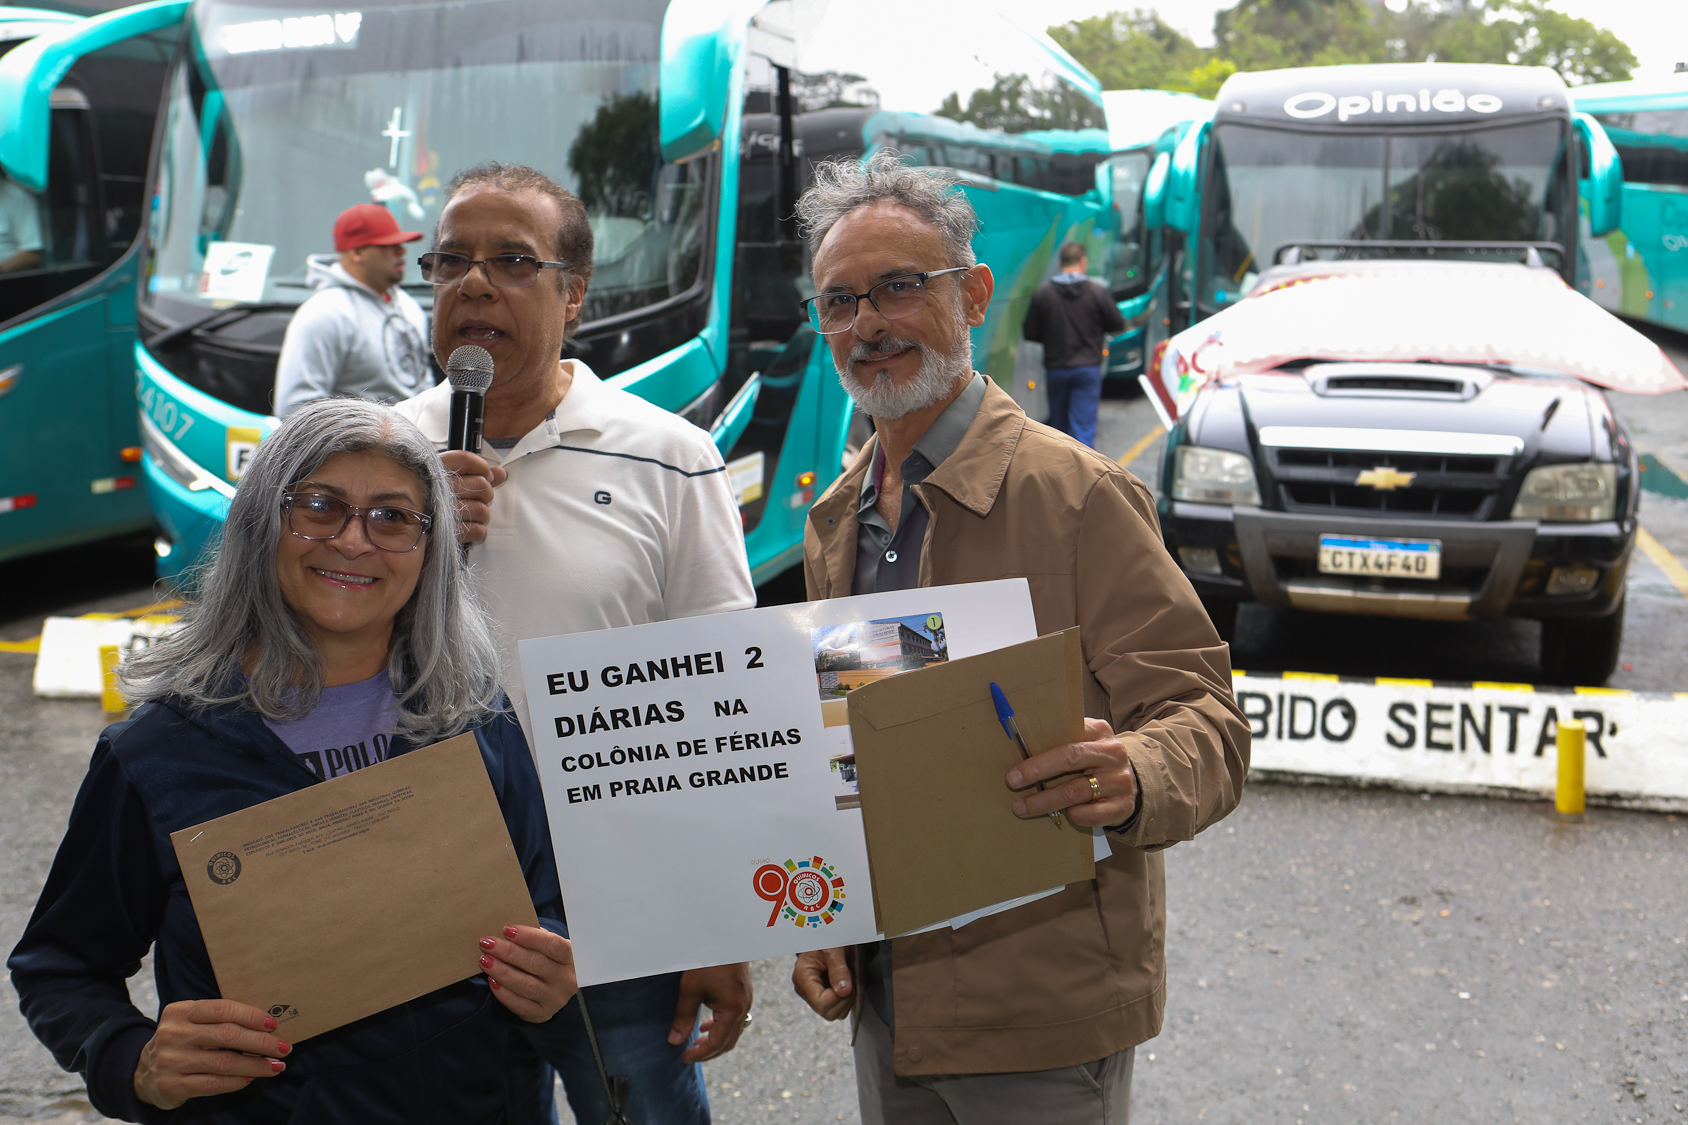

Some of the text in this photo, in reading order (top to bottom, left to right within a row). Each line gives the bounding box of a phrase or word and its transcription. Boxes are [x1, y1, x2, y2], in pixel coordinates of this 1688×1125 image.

[1283, 88, 1503, 122] Opinião
[594, 490, 612, 505] G
[1331, 551, 1427, 573] CTX4F40
[546, 646, 765, 696] EU GANHEI 2
[554, 698, 749, 738] DIÁRIAS NA
[1385, 702, 1607, 758] SENTAR
[325, 733, 388, 778] POLO
[561, 728, 802, 772] COLÔNIA DE FÉRIAS
[566, 761, 789, 804] EM PRAIA GRANDE
[242, 837, 263, 847] SINDICATO
[274, 821, 308, 836] TRABALHADORES
[323, 804, 357, 818] TRABALHADORAS
[803, 903, 821, 912] ABC
